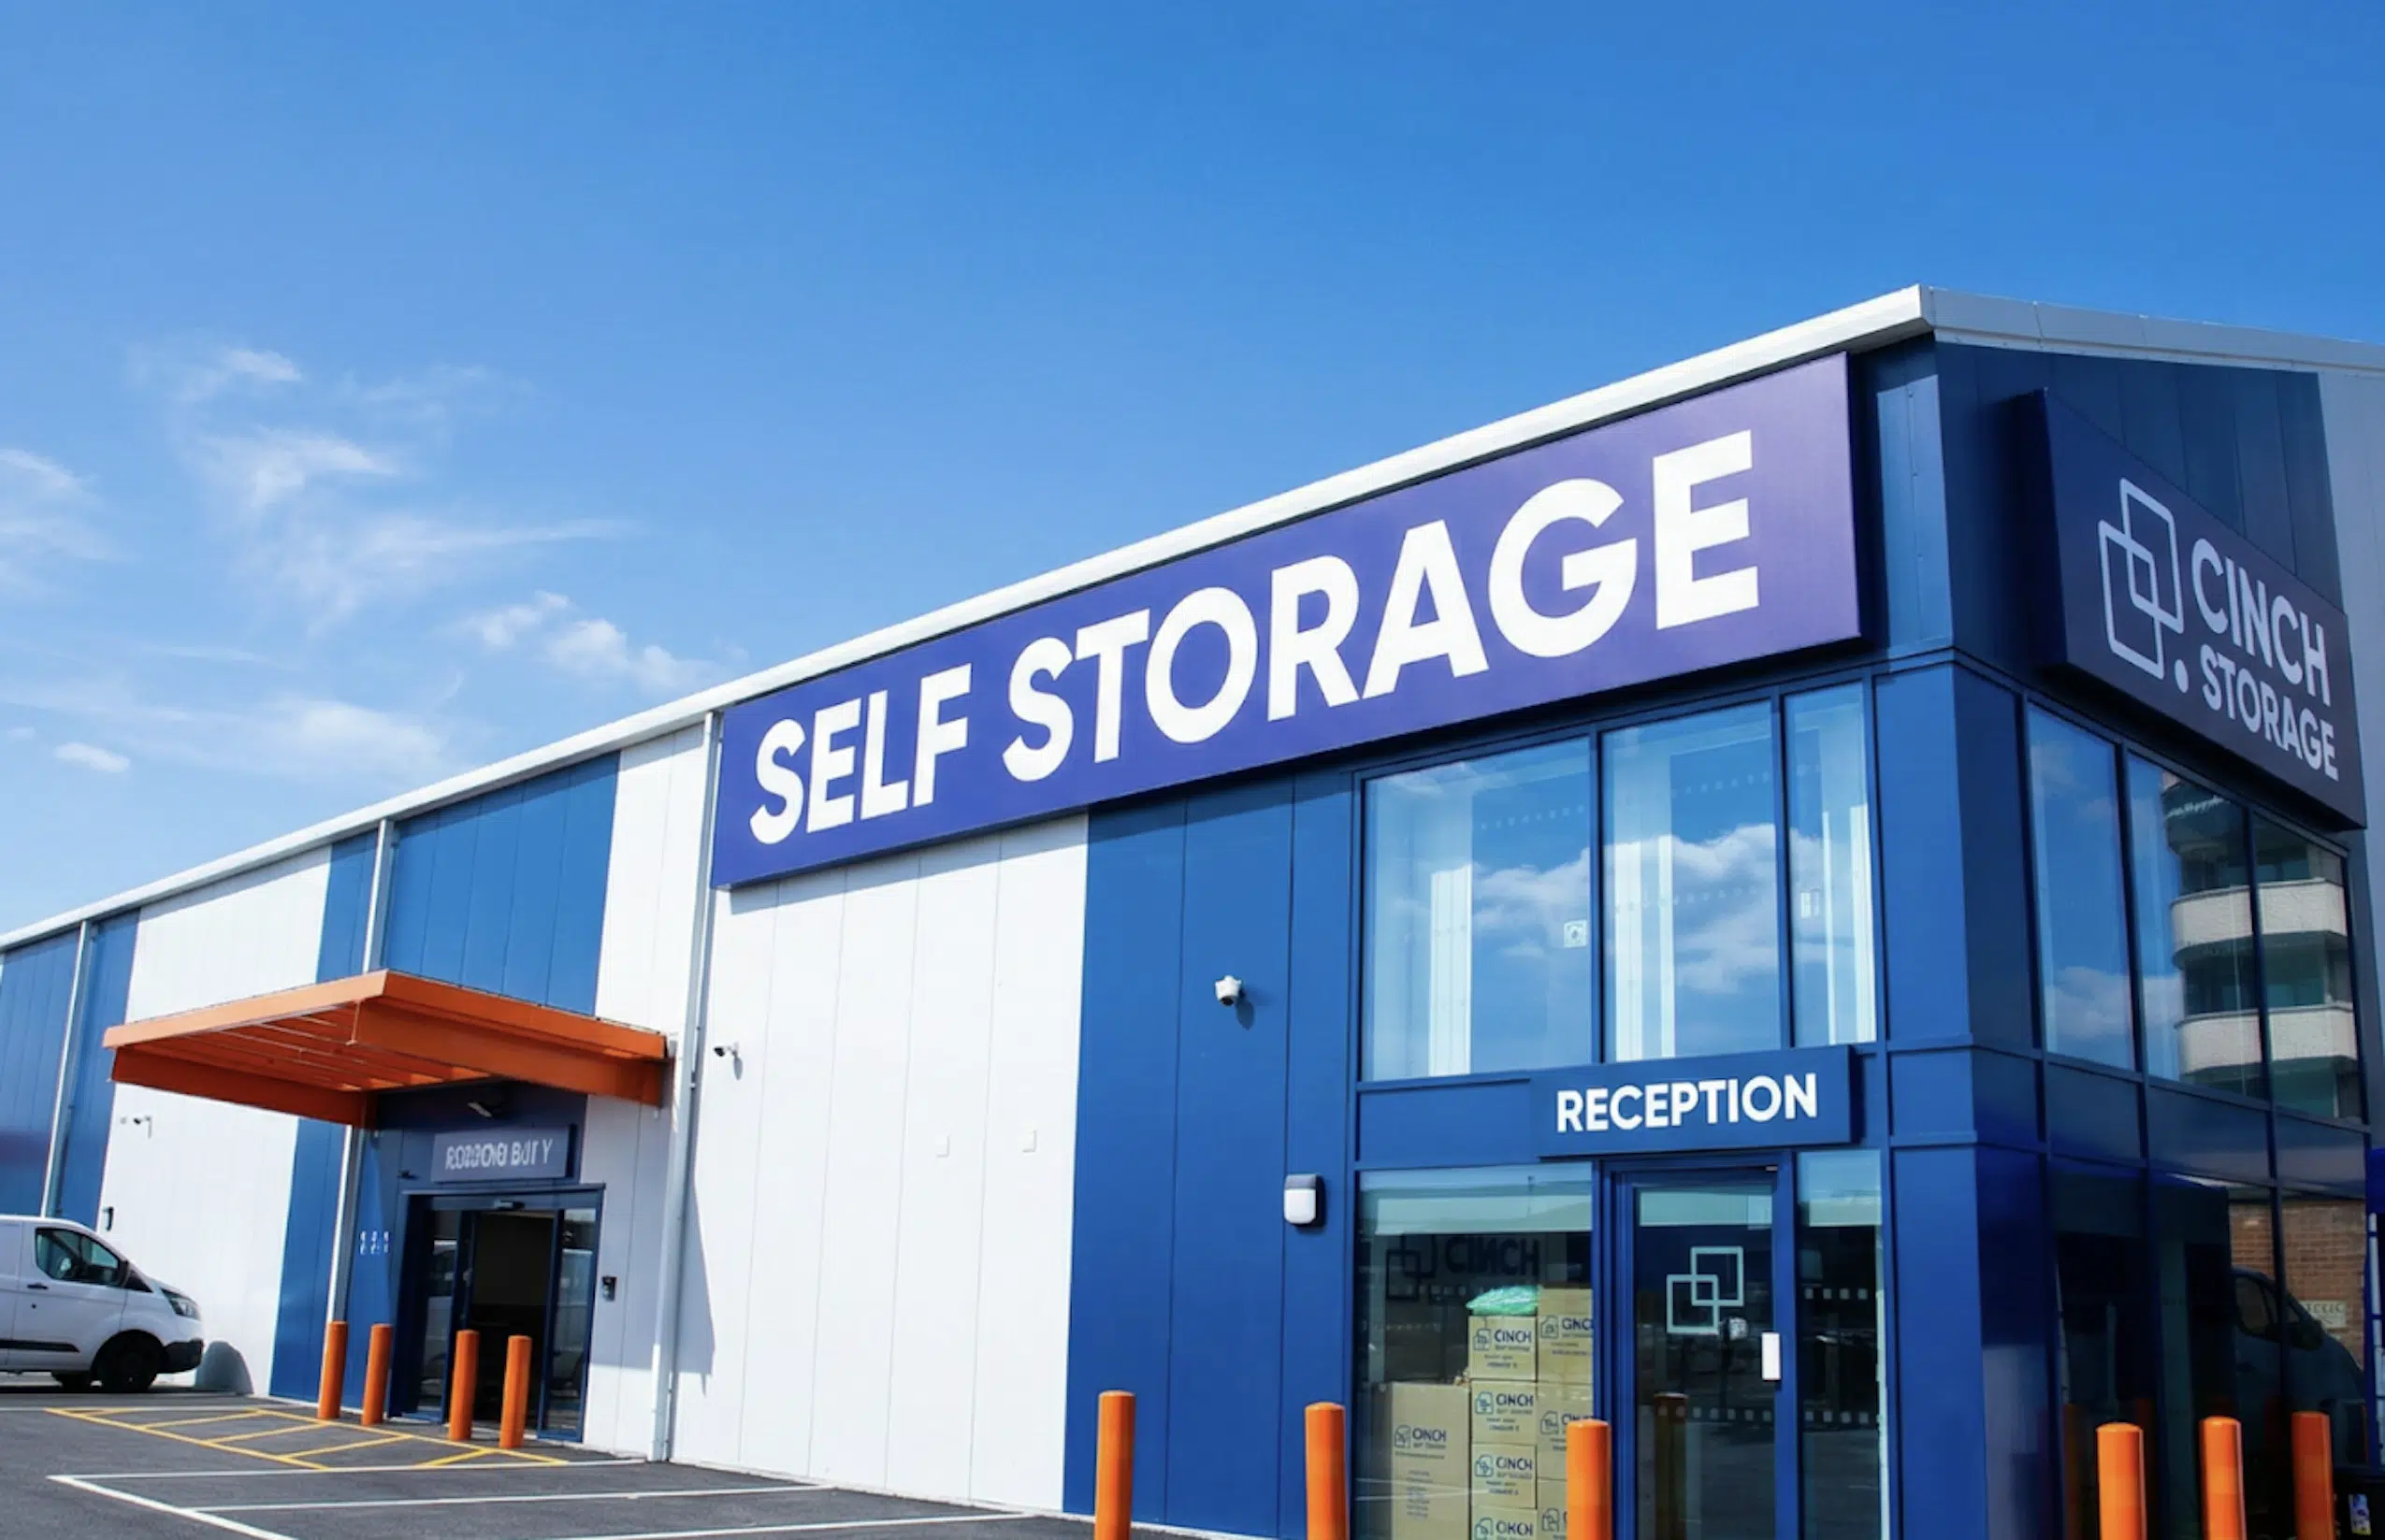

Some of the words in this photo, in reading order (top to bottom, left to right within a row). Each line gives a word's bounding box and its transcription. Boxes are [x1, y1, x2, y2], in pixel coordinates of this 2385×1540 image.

[749, 662, 972, 844] SELF
[1002, 429, 1760, 783] STORAGE
[2191, 538, 2331, 707] CINCH
[2200, 644, 2338, 782] STORAGE
[1556, 1072, 1817, 1132] RECEPTION
